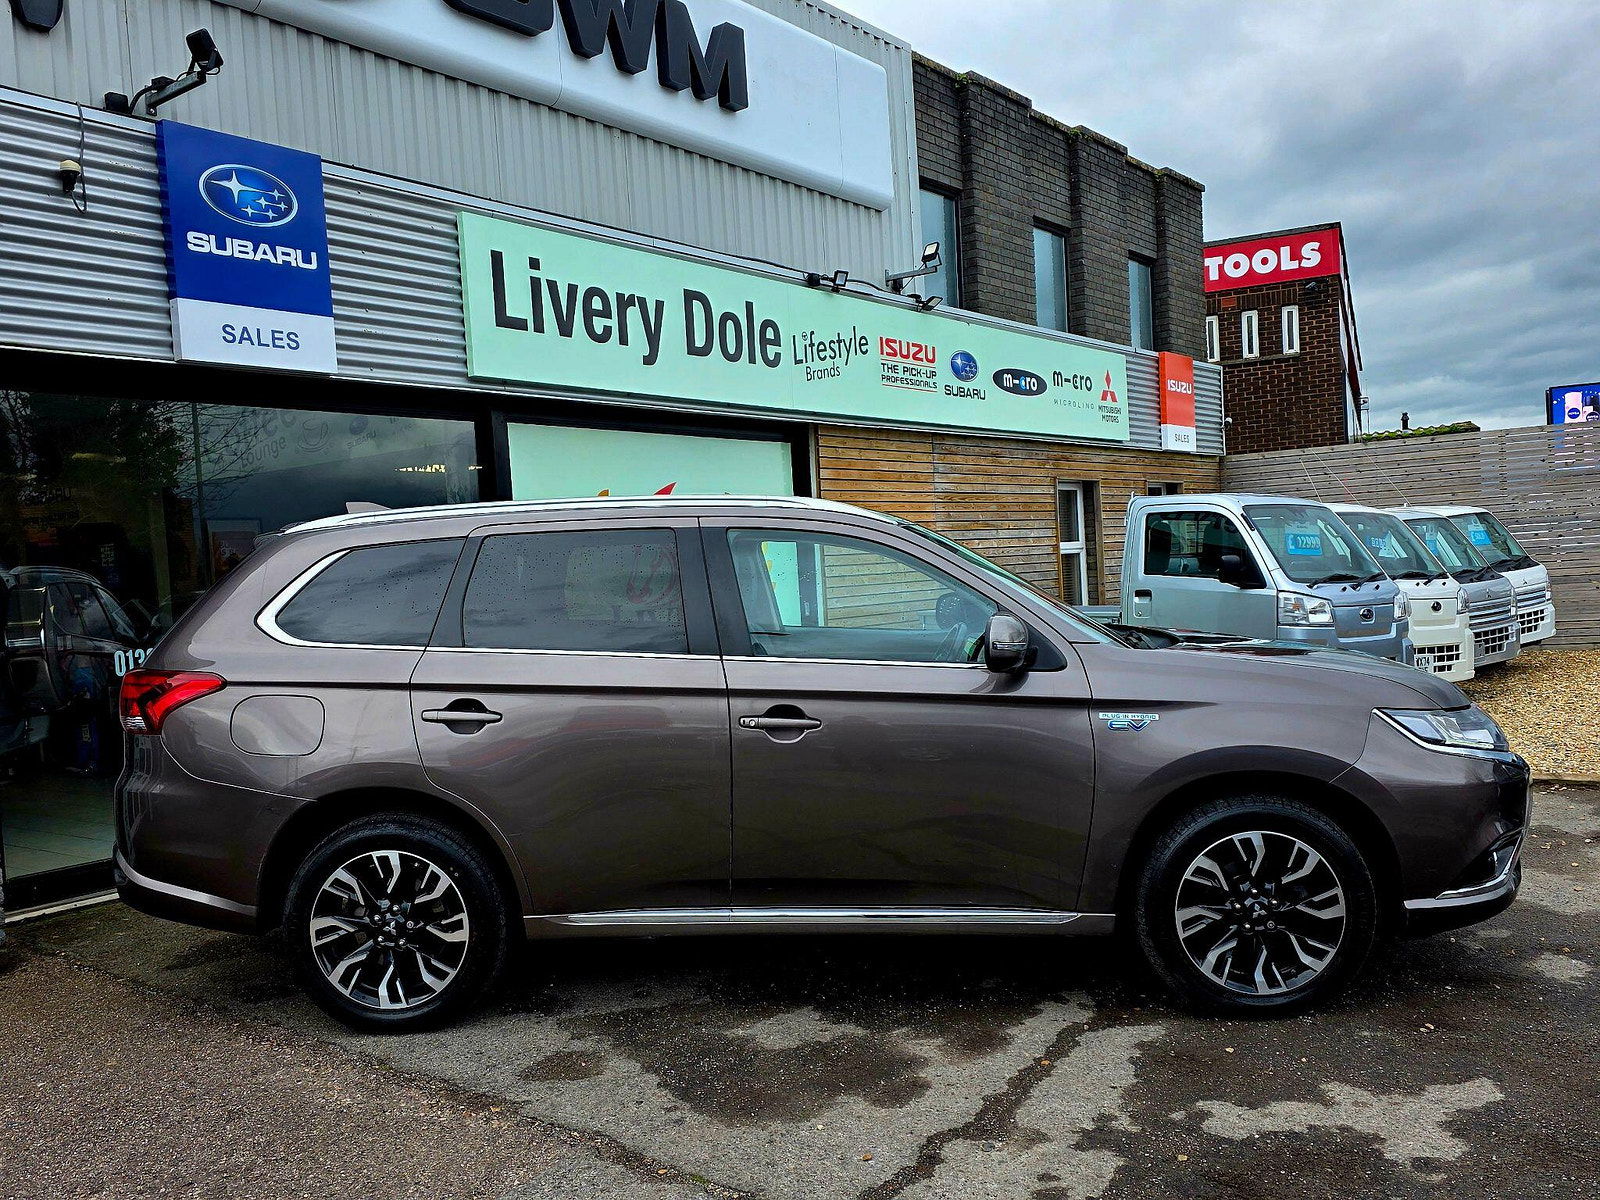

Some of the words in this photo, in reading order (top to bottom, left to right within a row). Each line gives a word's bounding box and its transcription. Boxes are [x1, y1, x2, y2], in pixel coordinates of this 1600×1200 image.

[186, 231, 318, 270] SUBARU
[1204, 241, 1321, 281] TOOLS
[490, 249, 665, 366] Livery
[683, 288, 782, 368] Dole
[222, 323, 300, 350] SALES
[792, 326, 869, 366] Lifestyle
[879, 336, 936, 364] ISUZU
[805, 361, 841, 382] Brands
[881, 362, 899, 375] THE
[902, 366, 937, 379] PICK-UP
[881, 374, 938, 389] PROFESSIONALS
[1167, 379, 1192, 395] ISUZU
[944, 384, 986, 401] SUBARU
[1054, 398, 1095, 410] MICROLINO
[1102, 414, 1120, 424] MOTORS
[1175, 433, 1190, 444] SALES
[114, 647, 153, 677] 013
[1108, 719, 1151, 731] EV
